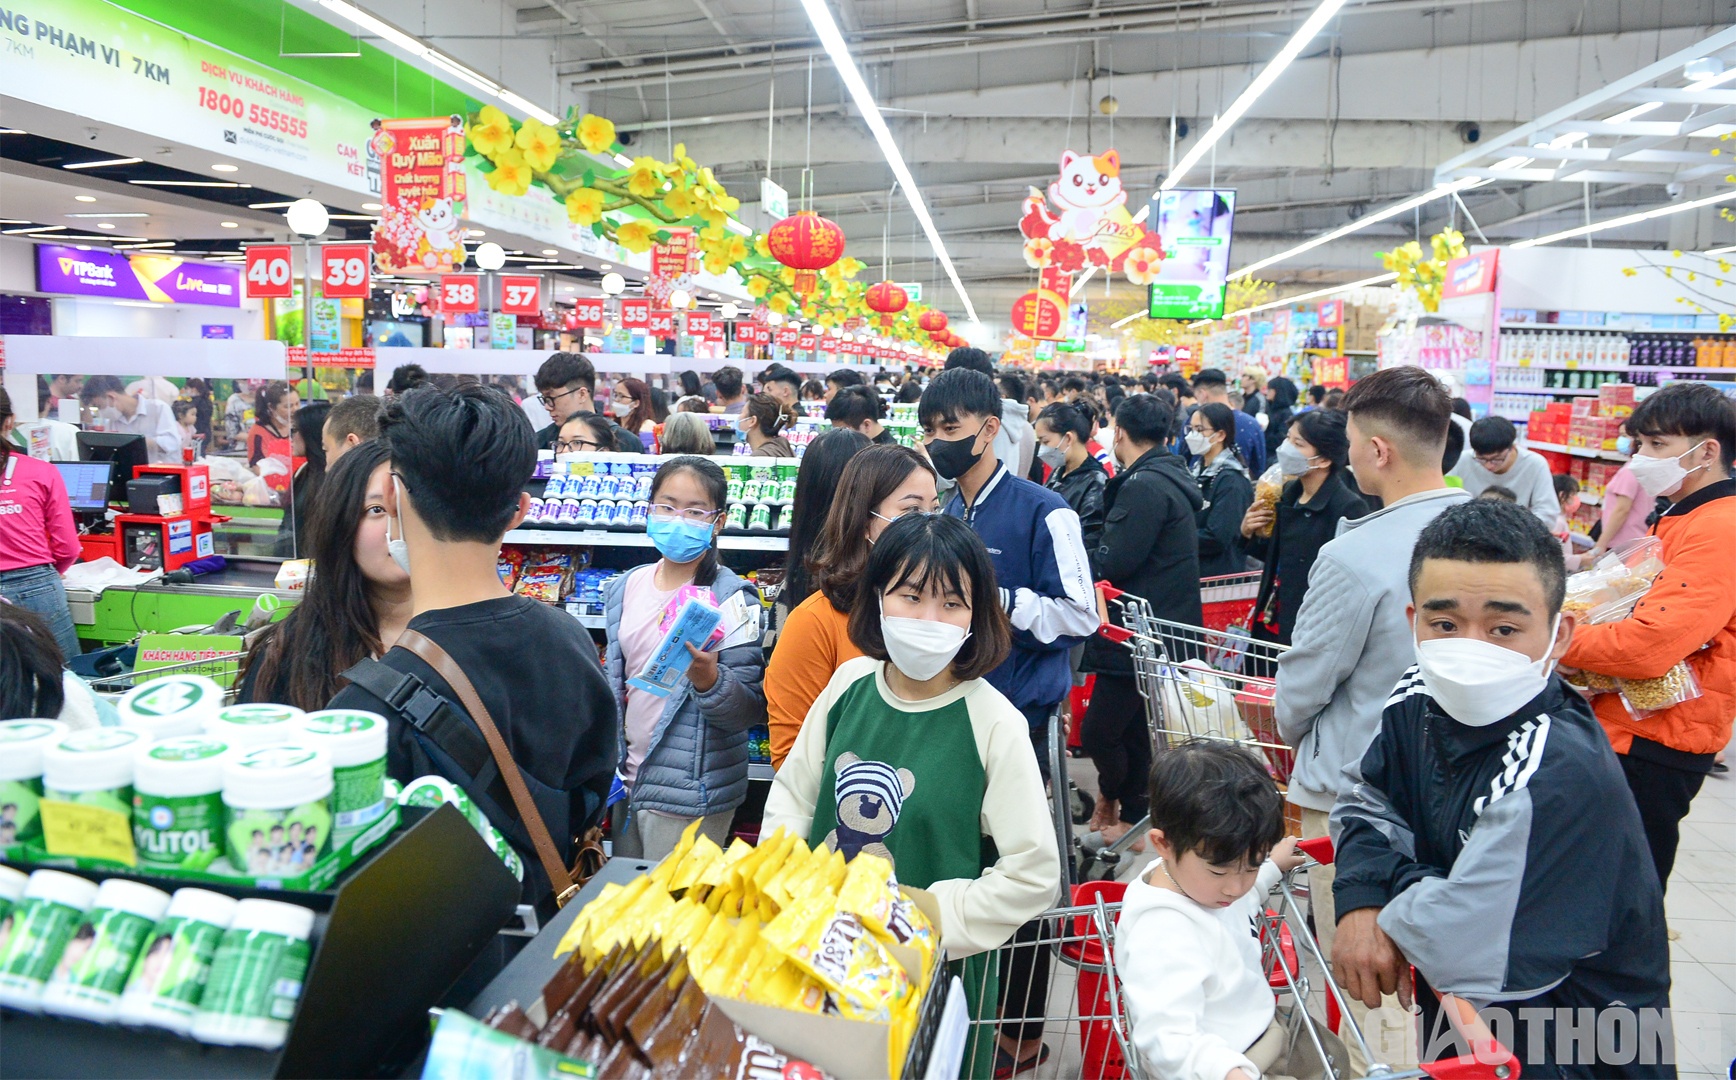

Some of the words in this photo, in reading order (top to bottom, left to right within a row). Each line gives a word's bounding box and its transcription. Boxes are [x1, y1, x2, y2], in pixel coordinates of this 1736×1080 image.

[5, 37, 35, 60] 7KM
[35, 20, 96, 59] PHẠM
[100, 44, 121, 68] VI
[201, 60, 227, 80] DỊCH
[228, 70, 243, 87] VỤ
[245, 76, 278, 98] KHÁCH
[279, 88, 305, 108] HÀNG
[199, 86, 245, 119] 1800
[248, 103, 308, 140] 555555
[408, 133, 441, 151] Xuân
[336, 143, 358, 160] CAM
[391, 151, 416, 170] Quý
[417, 151, 444, 168] Mão
[347, 160, 365, 177] KẾT
[1095, 217, 1137, 239] 2023
[72, 260, 114, 280] TPBank
[248, 258, 290, 287] 40
[325, 258, 367, 287] 39
[444, 283, 476, 305] 38
[505, 285, 536, 306] 37
[577, 305, 601, 321] 36
[624, 306, 649, 322] 35
[651, 317, 671, 331] 34
[689, 317, 709, 332] 33
[740, 326, 754, 339] 31
[780, 331, 797, 343] 29
[800, 337, 816, 348] 27
[822, 340, 836, 349] 25
[142, 647, 172, 661] KHÁCH
[173, 648, 197, 661] HÀNG
[198, 646, 217, 660] TIẾP
